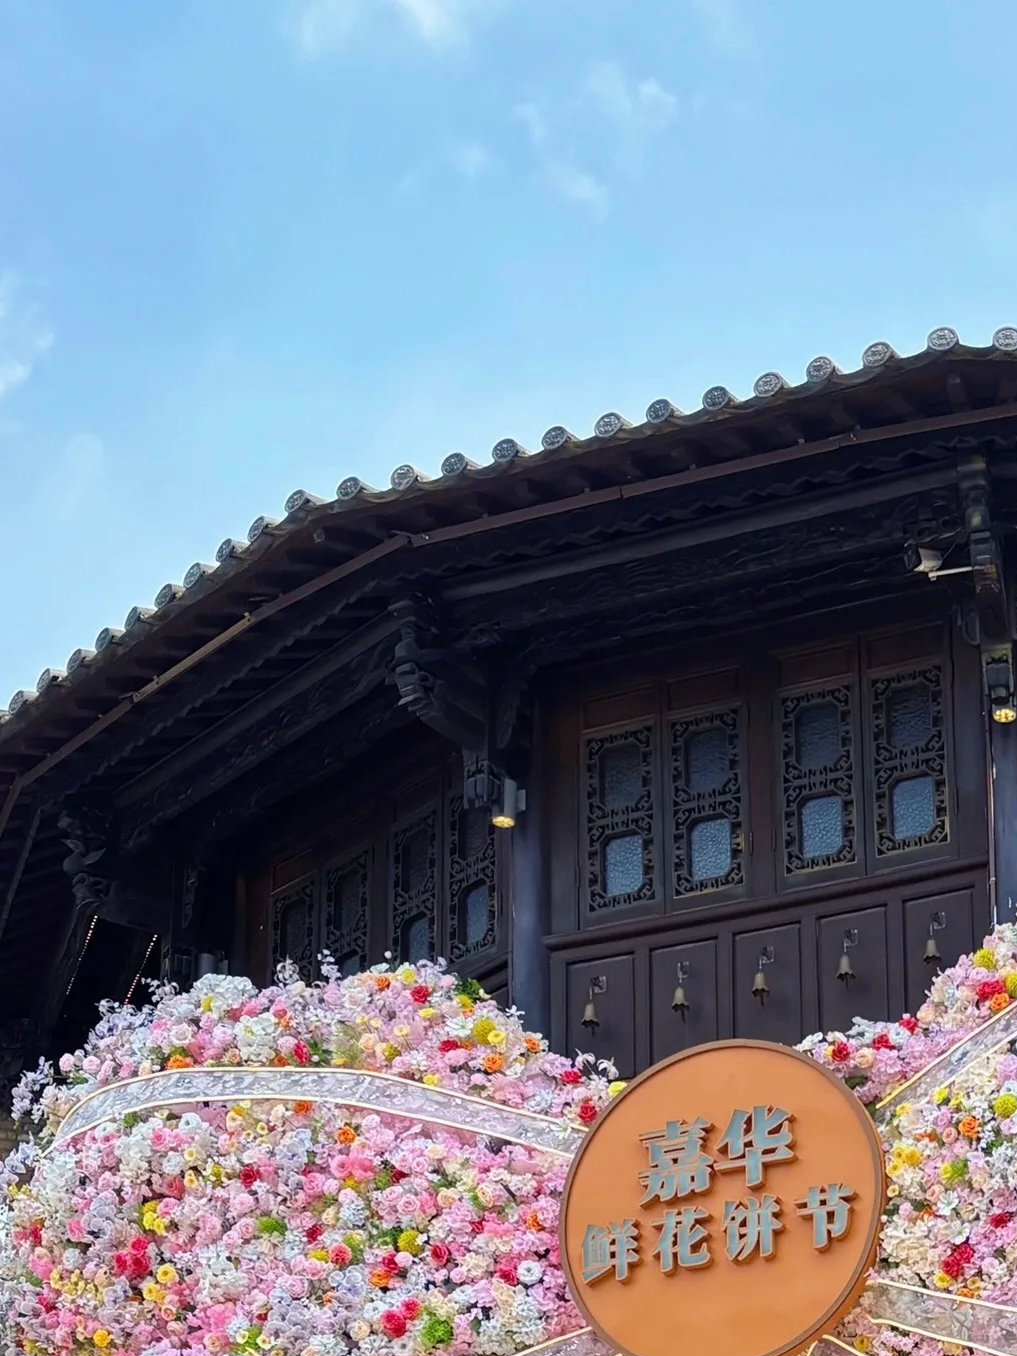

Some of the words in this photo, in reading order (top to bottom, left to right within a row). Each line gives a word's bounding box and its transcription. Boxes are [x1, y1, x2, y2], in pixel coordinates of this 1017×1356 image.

[639, 1105, 797, 1208] 嘉华
[581, 1183, 858, 1286] 鲜花饼节
